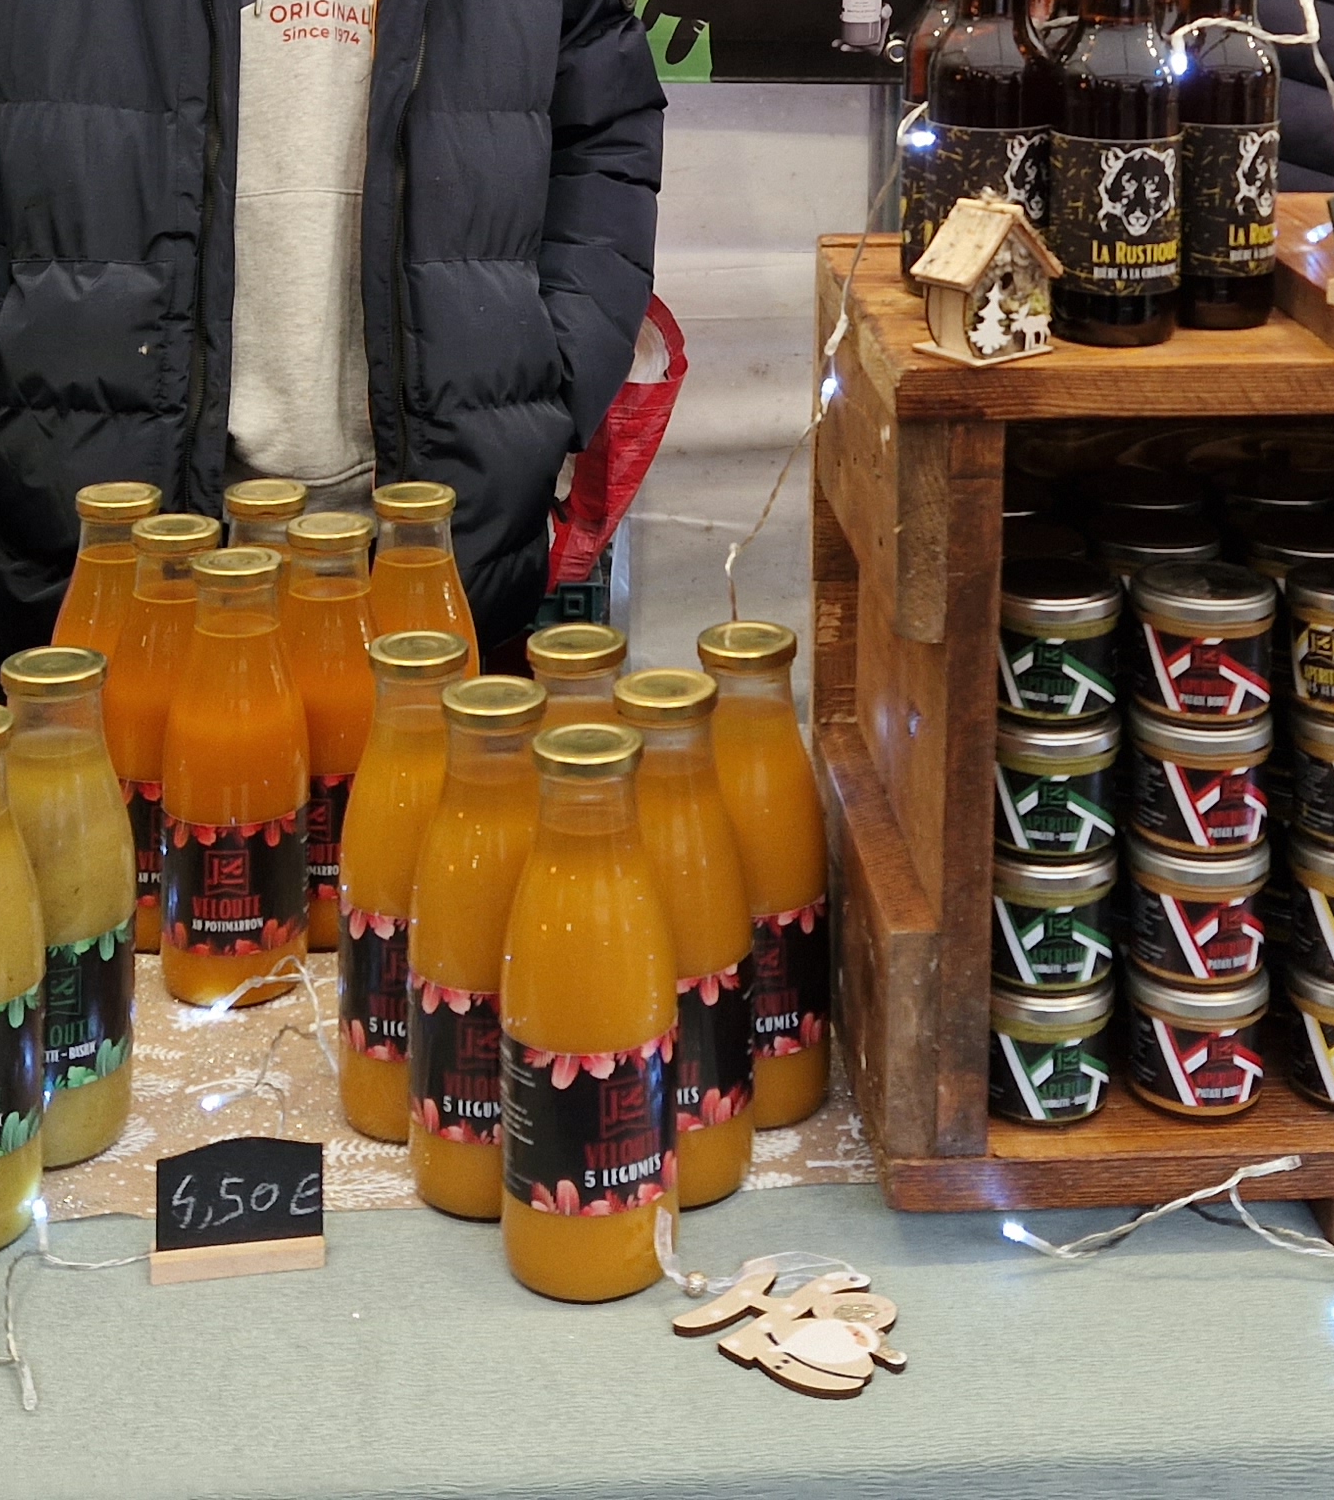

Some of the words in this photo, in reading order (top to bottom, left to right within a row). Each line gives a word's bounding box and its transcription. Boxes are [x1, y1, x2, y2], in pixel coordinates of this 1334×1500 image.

[282, 26, 330, 42] Since
[334, 27, 361, 45] 1974
[583, 1170, 597, 1189] 5
